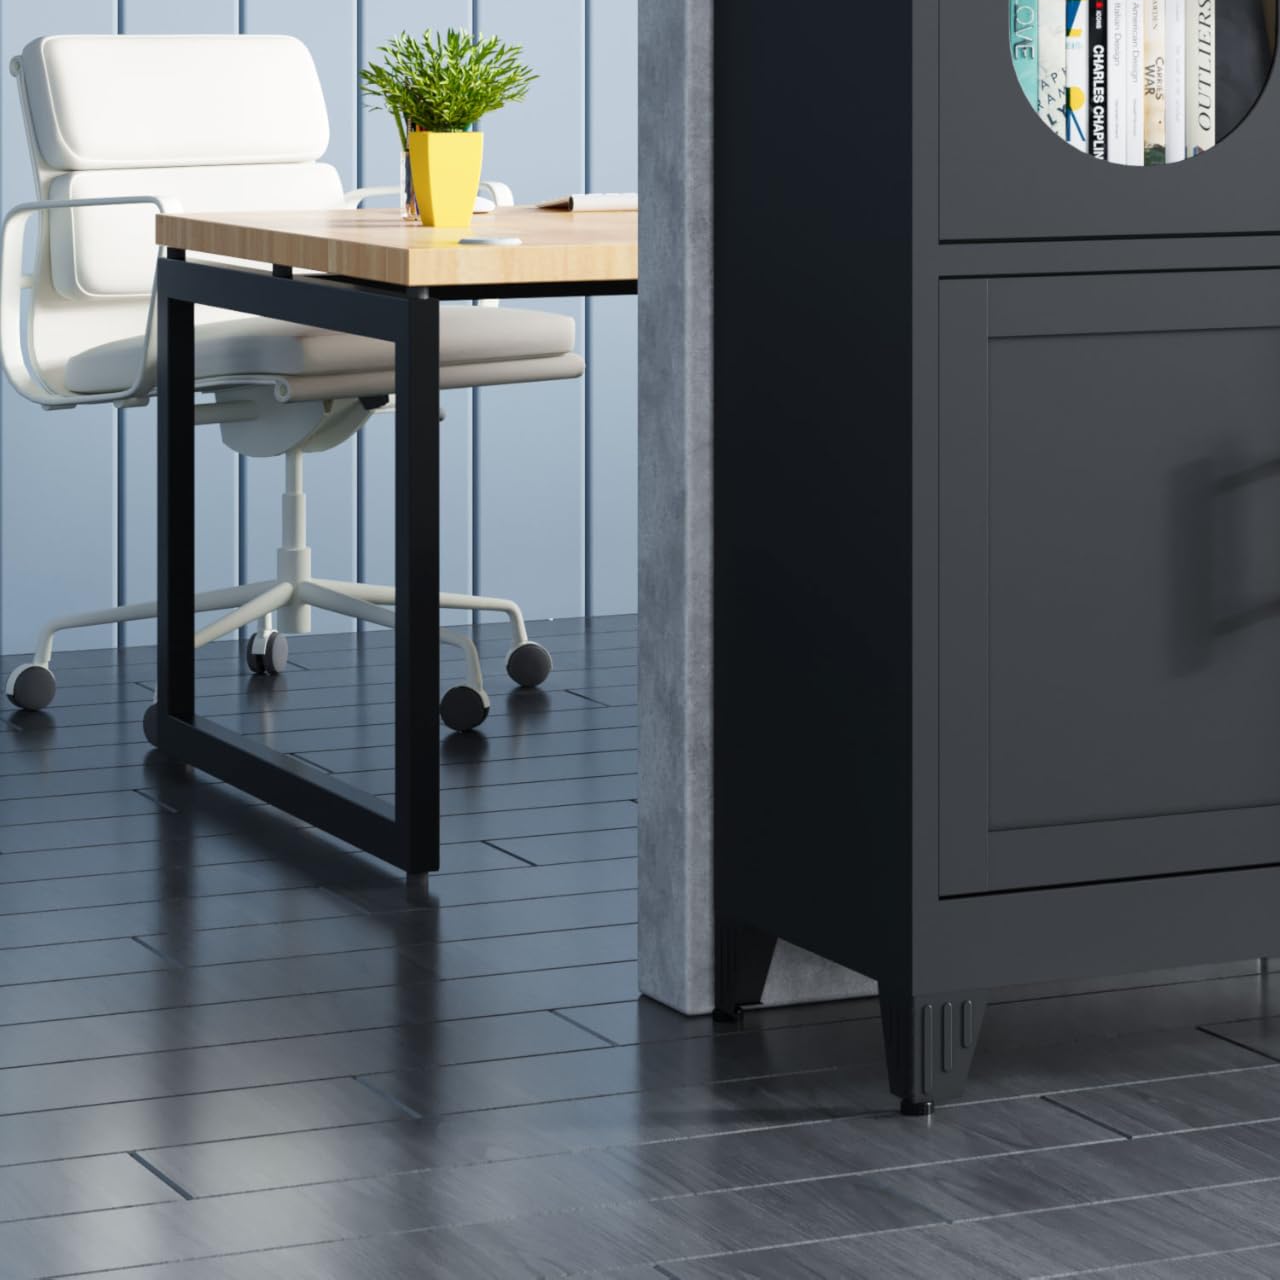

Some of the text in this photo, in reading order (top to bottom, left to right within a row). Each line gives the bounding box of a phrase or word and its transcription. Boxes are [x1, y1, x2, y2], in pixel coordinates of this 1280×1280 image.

[1093, 44, 1104, 160] CHARLES CHAPLIN
[1144, 64, 1156, 96] WAR
